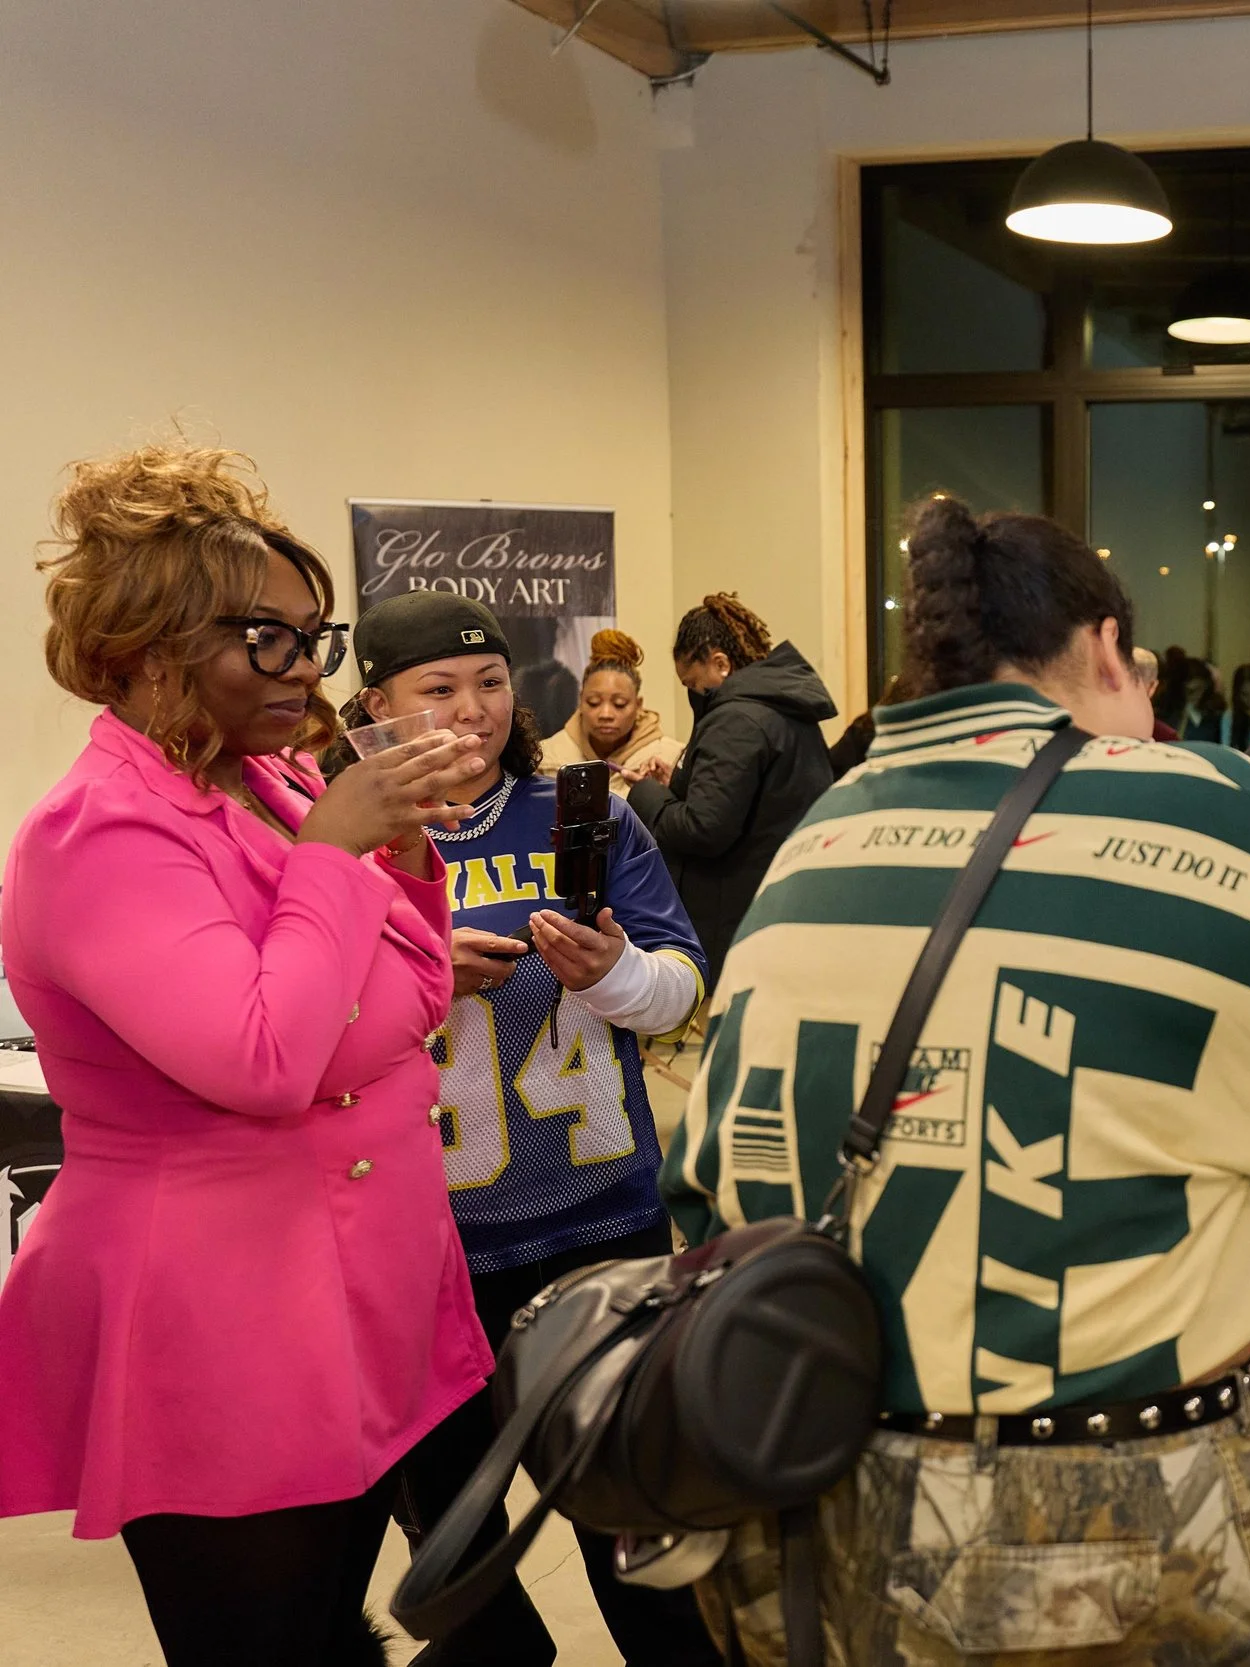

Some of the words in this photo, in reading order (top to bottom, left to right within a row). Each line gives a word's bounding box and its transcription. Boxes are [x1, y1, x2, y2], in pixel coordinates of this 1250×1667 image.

[361, 528, 450, 596] Glo
[455, 528, 608, 572] Brows
[408, 575, 503, 605] BODY
[508, 577, 571, 605] ART
[861, 824, 925, 849] JUST
[921, 825, 966, 849] DO
[1093, 835, 1172, 868] JUST
[1171, 850, 1215, 881] DO
[1217, 863, 1249, 892] IT
